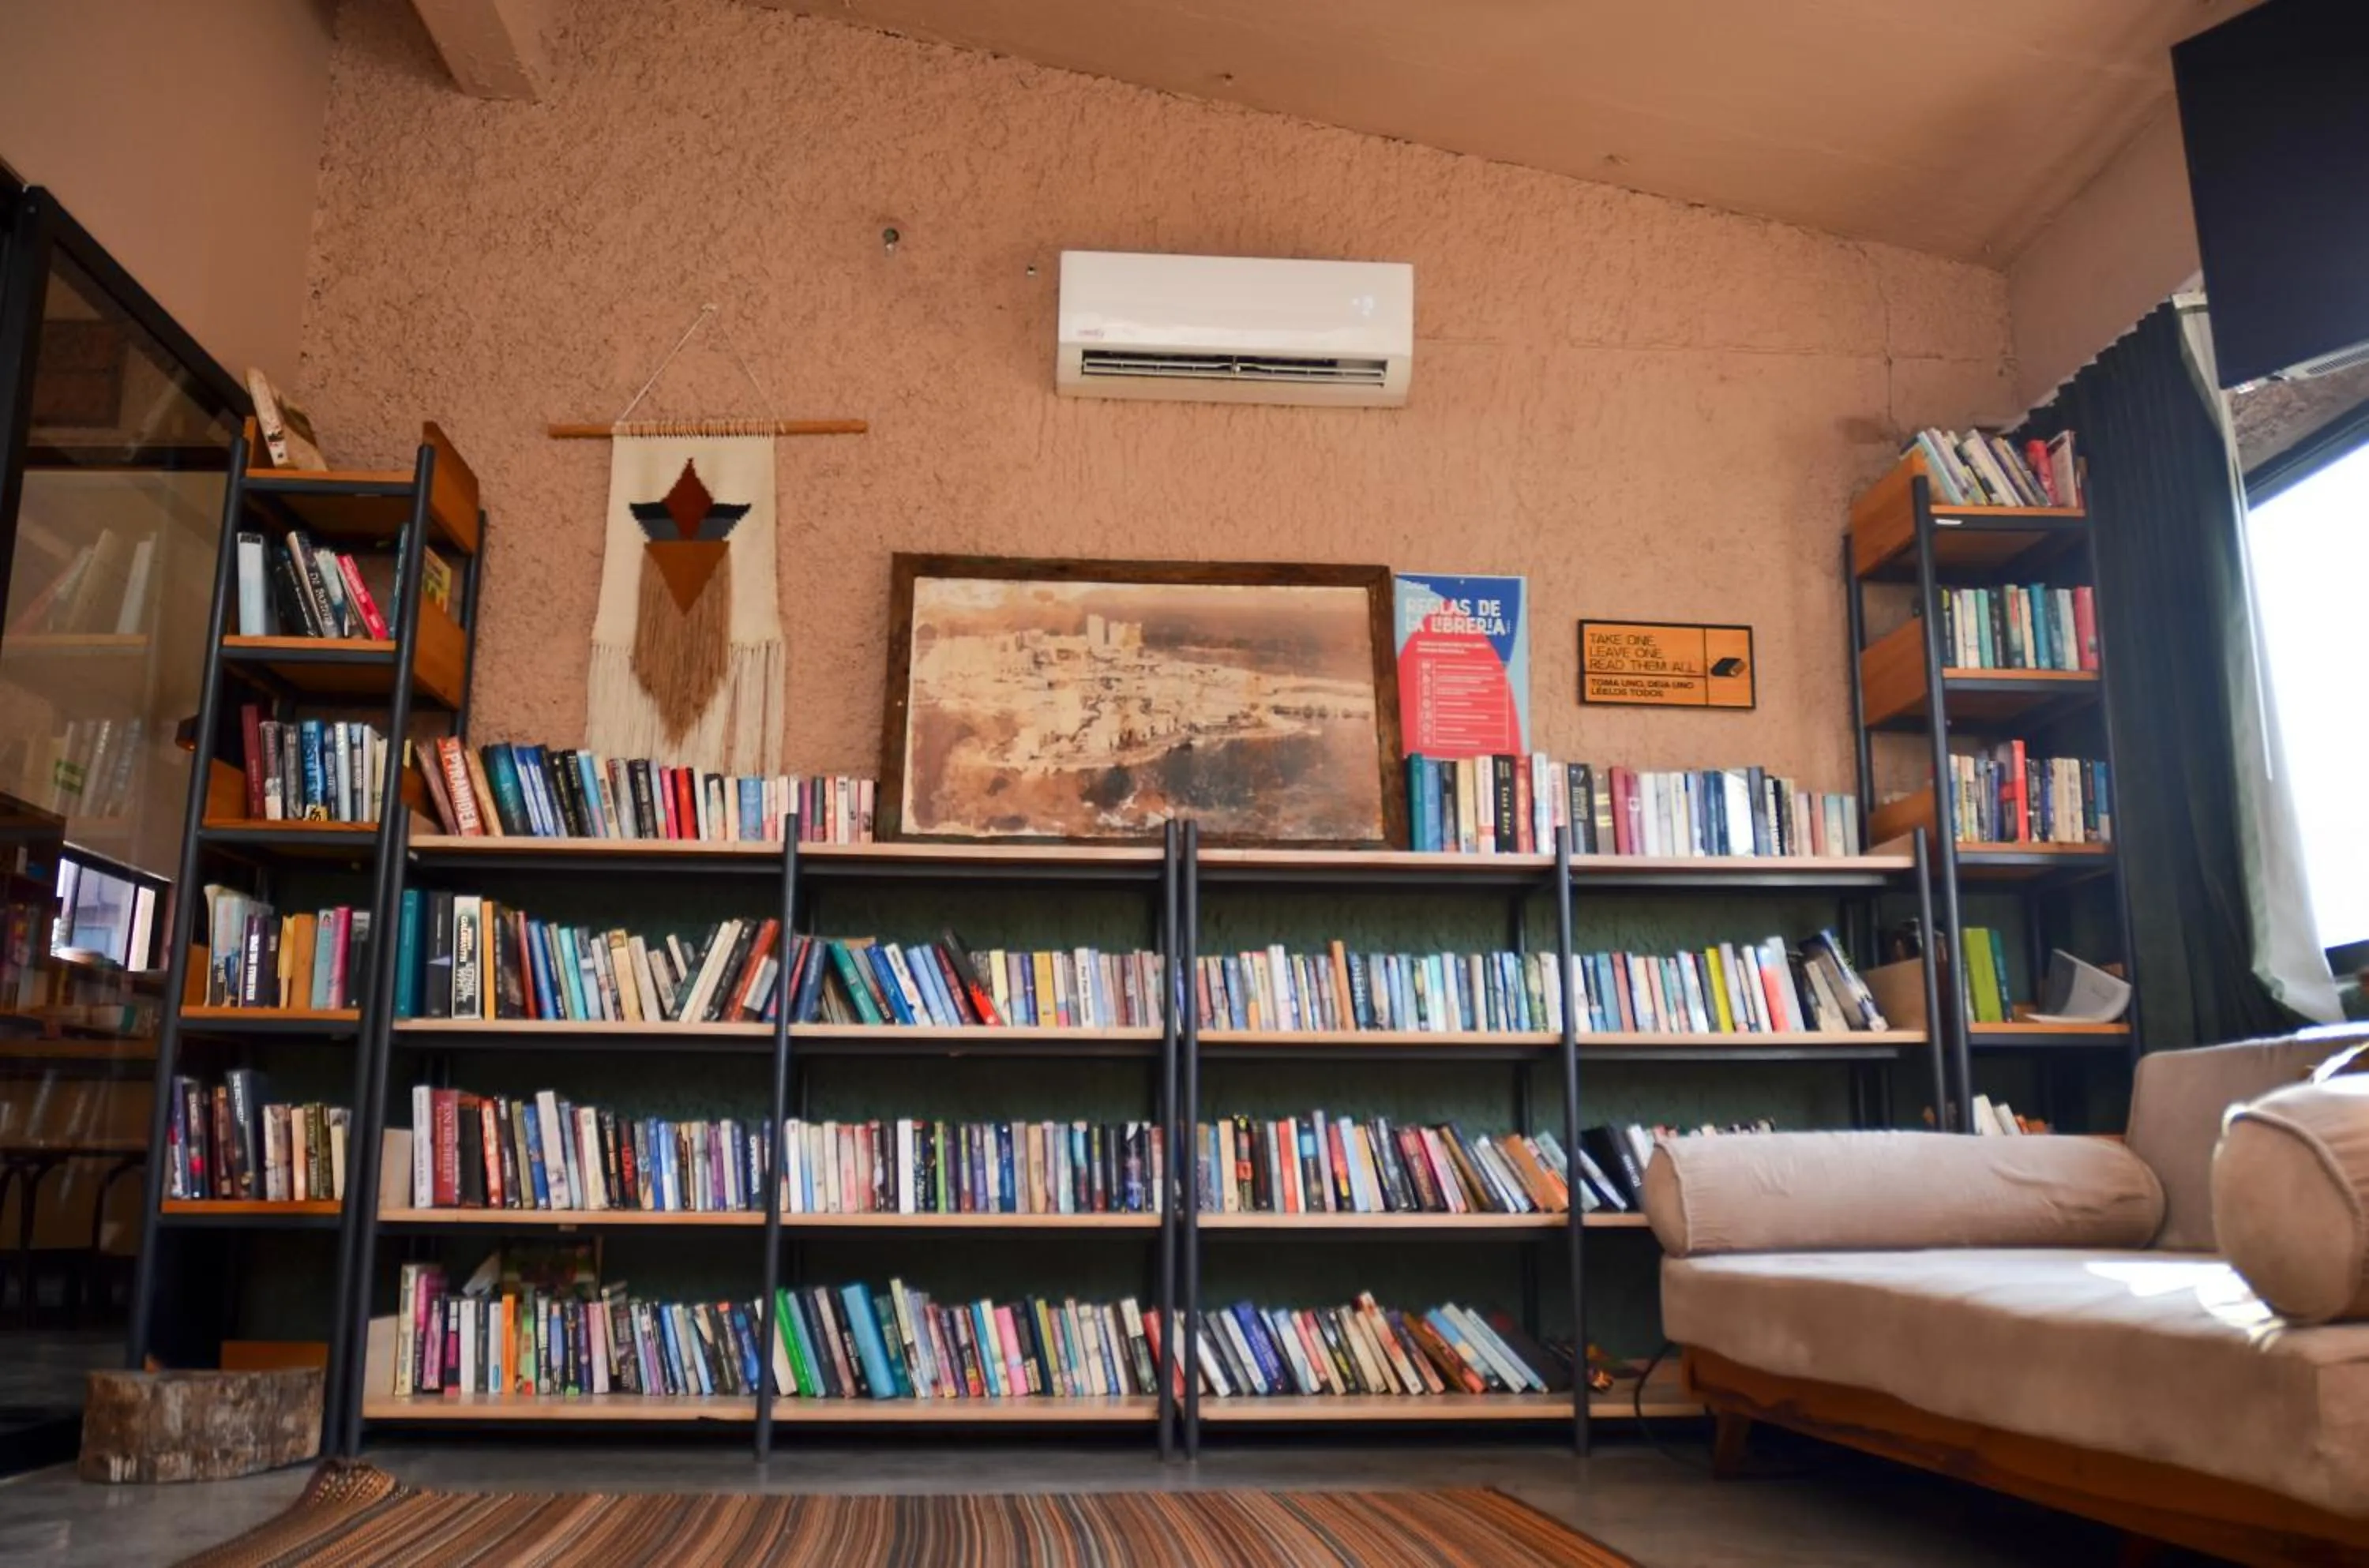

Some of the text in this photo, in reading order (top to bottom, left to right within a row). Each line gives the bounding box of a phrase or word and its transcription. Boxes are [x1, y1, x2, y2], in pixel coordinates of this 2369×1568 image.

[1477, 599, 1502, 617] DE
[1590, 632, 1622, 645] TAKE
[1590, 646, 1631, 658] LEAVE
[1590, 658, 1625, 670] READ
[1630, 659, 1667, 671] THEM
